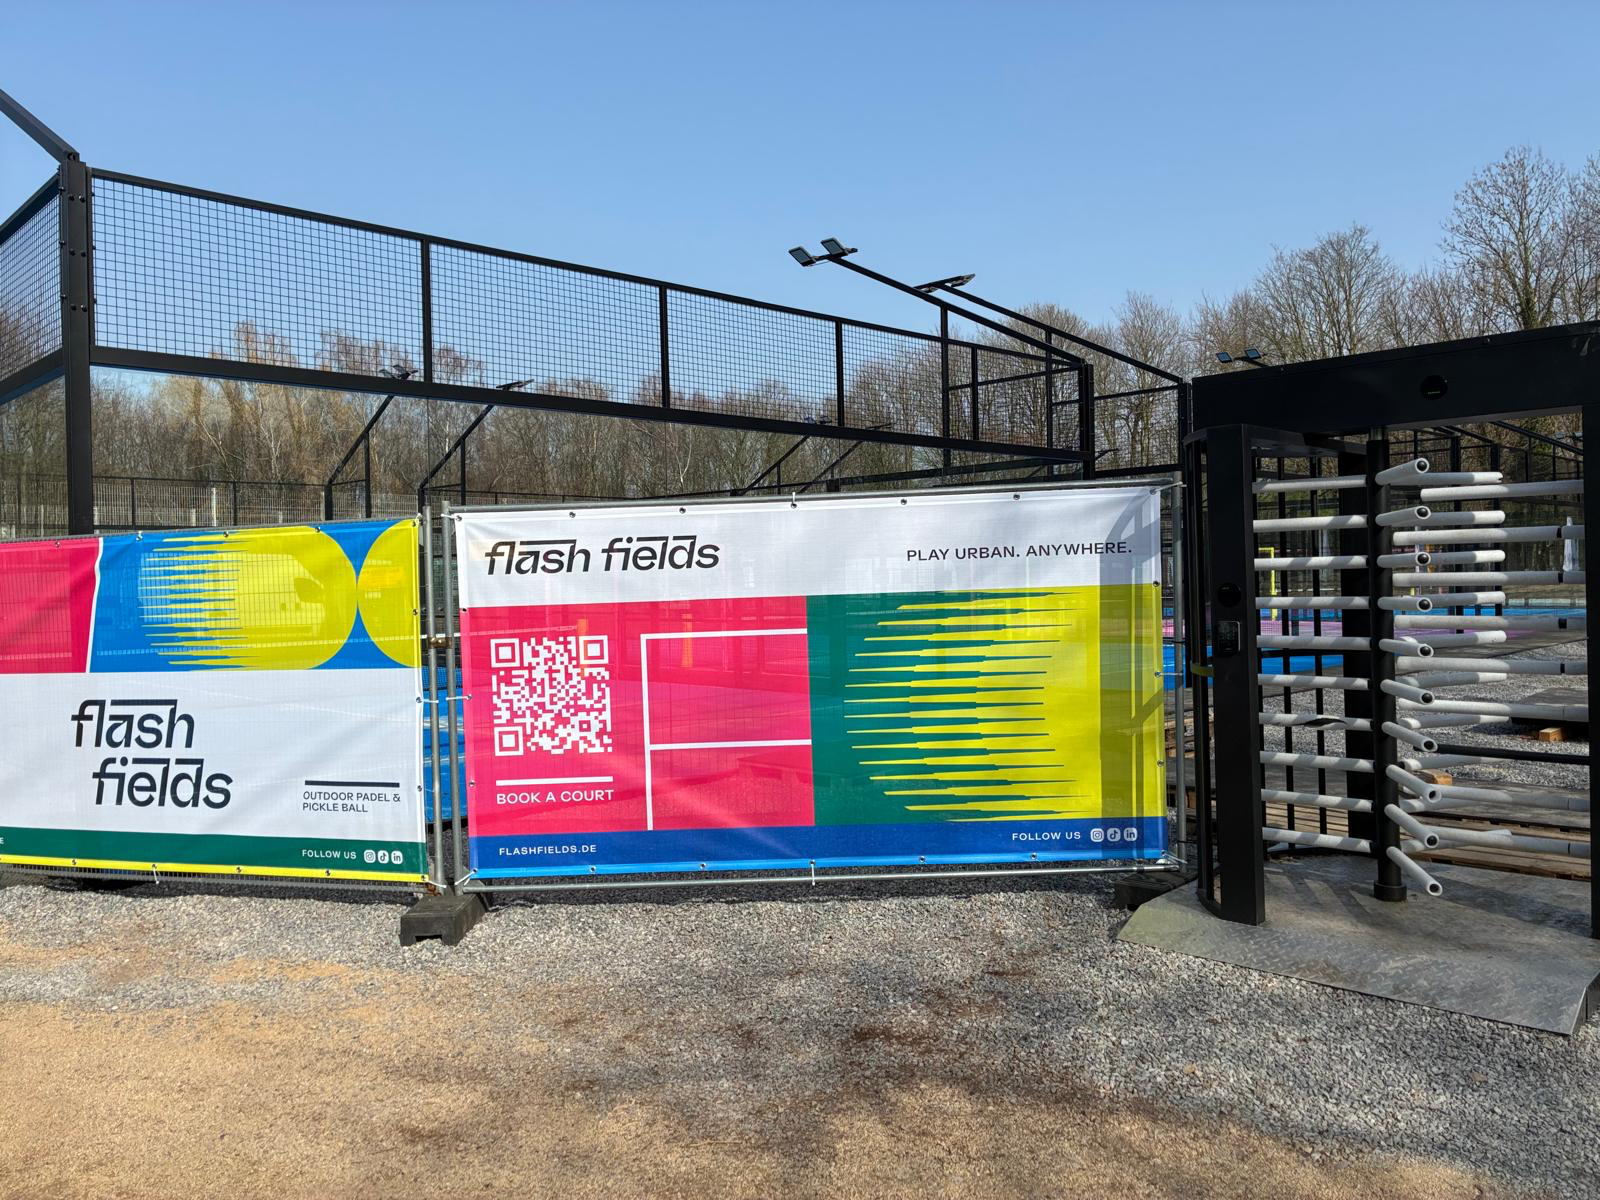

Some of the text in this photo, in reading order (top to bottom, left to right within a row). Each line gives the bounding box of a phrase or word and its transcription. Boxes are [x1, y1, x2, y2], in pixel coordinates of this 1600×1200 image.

[485, 535, 720, 575] flash fields
[907, 541, 1132, 561] PLAY URBAN. ANYWHERE.
[71, 699, 195, 748] flash
[92, 756, 233, 809] fields
[303, 791, 401, 802] OUTDOOR PADEL &
[496, 789, 614, 804] BOOK A COURT
[302, 803, 368, 813] PICKLE BALL
[1012, 831, 1081, 841] FOLLOW US
[302, 849, 357, 860] FOLLOW US
[499, 844, 597, 856] FLASHFIELDS.DE
